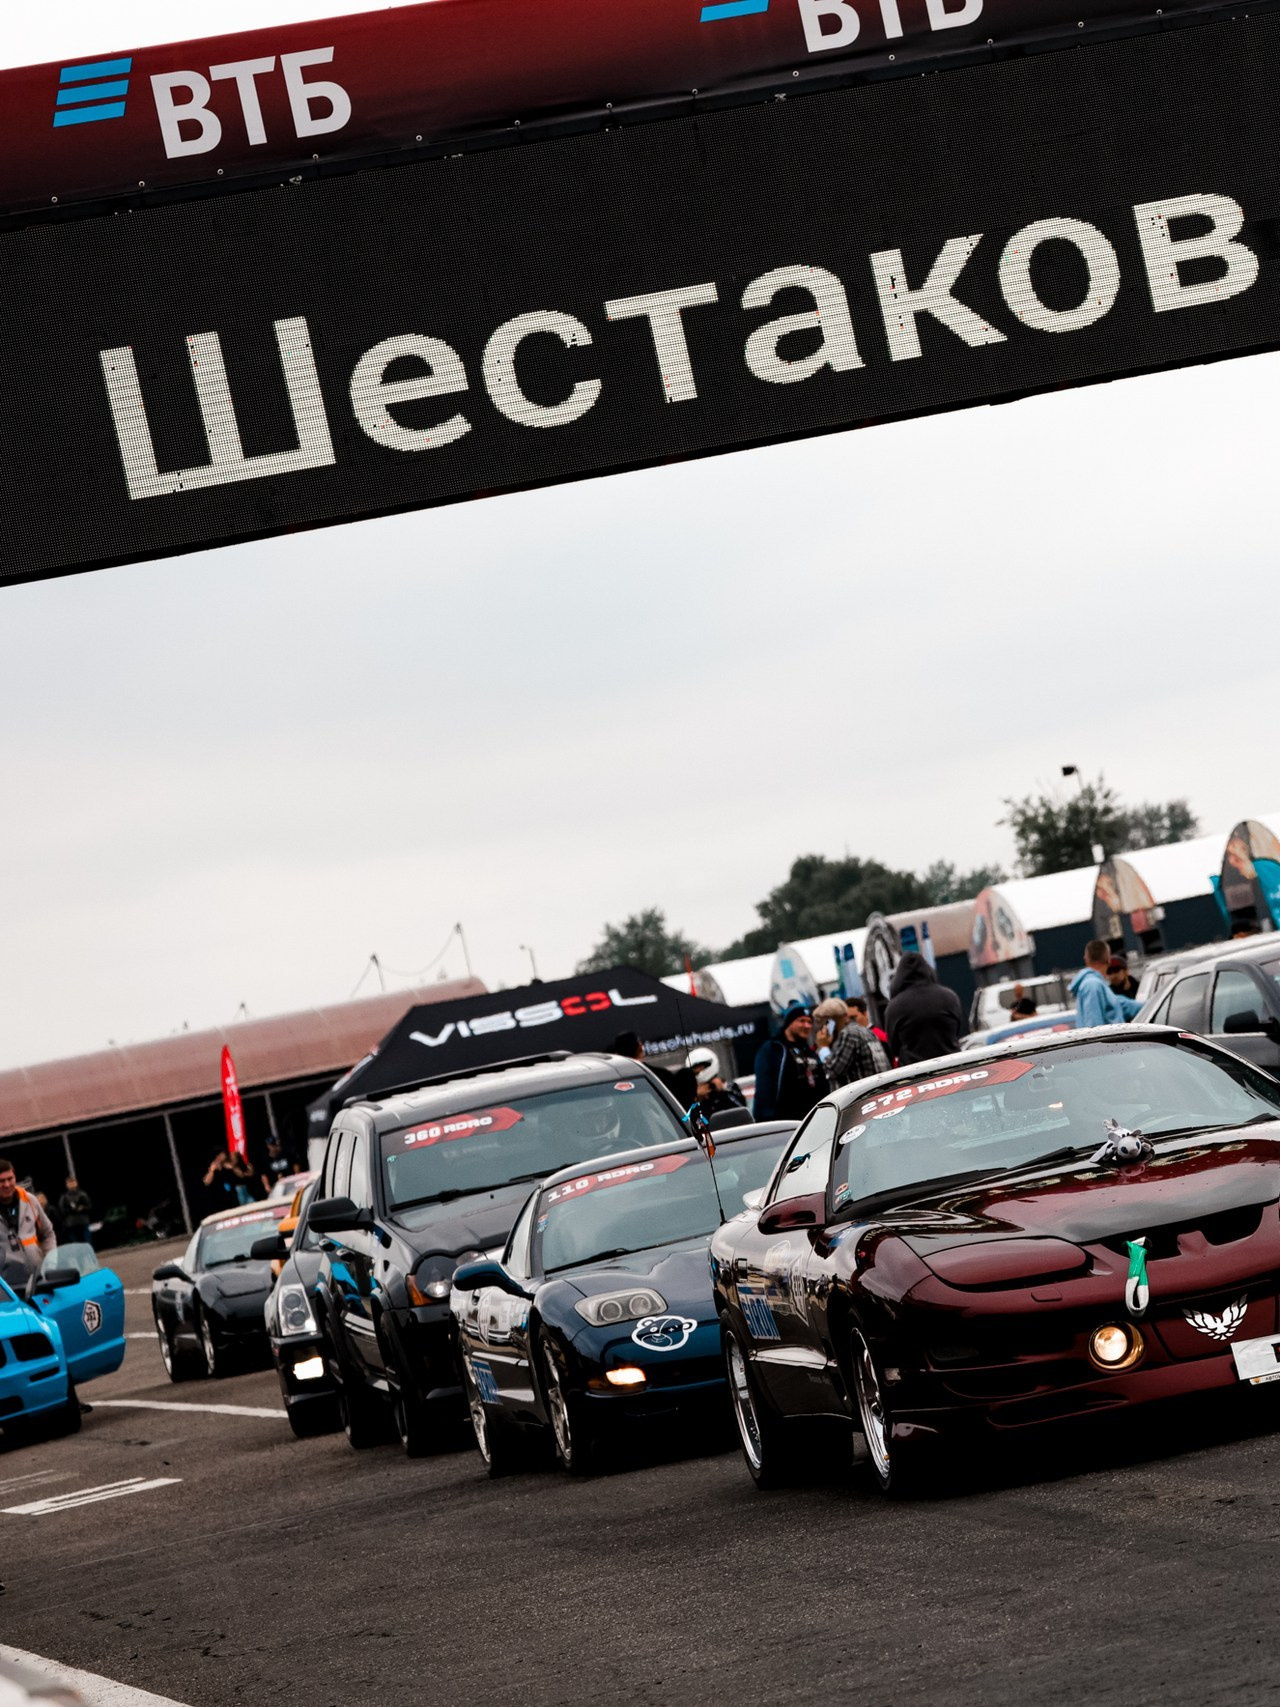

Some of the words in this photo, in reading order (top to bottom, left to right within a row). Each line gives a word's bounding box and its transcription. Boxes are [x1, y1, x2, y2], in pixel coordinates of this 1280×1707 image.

[150, 46, 352, 159] ВТБ
[99, 192, 1260, 500] Шестаков
[409, 989, 658, 1047] VISSOL
[642, 1021, 755, 1055] issolwheels.ru
[861, 1089, 913, 1115] 272
[916, 1071, 989, 1093] RDRC
[404, 1126, 441, 1145] 360
[443, 1116, 493, 1134] RDRC
[548, 1179, 589, 1202] 110
[597, 1163, 655, 1182] RDRC
